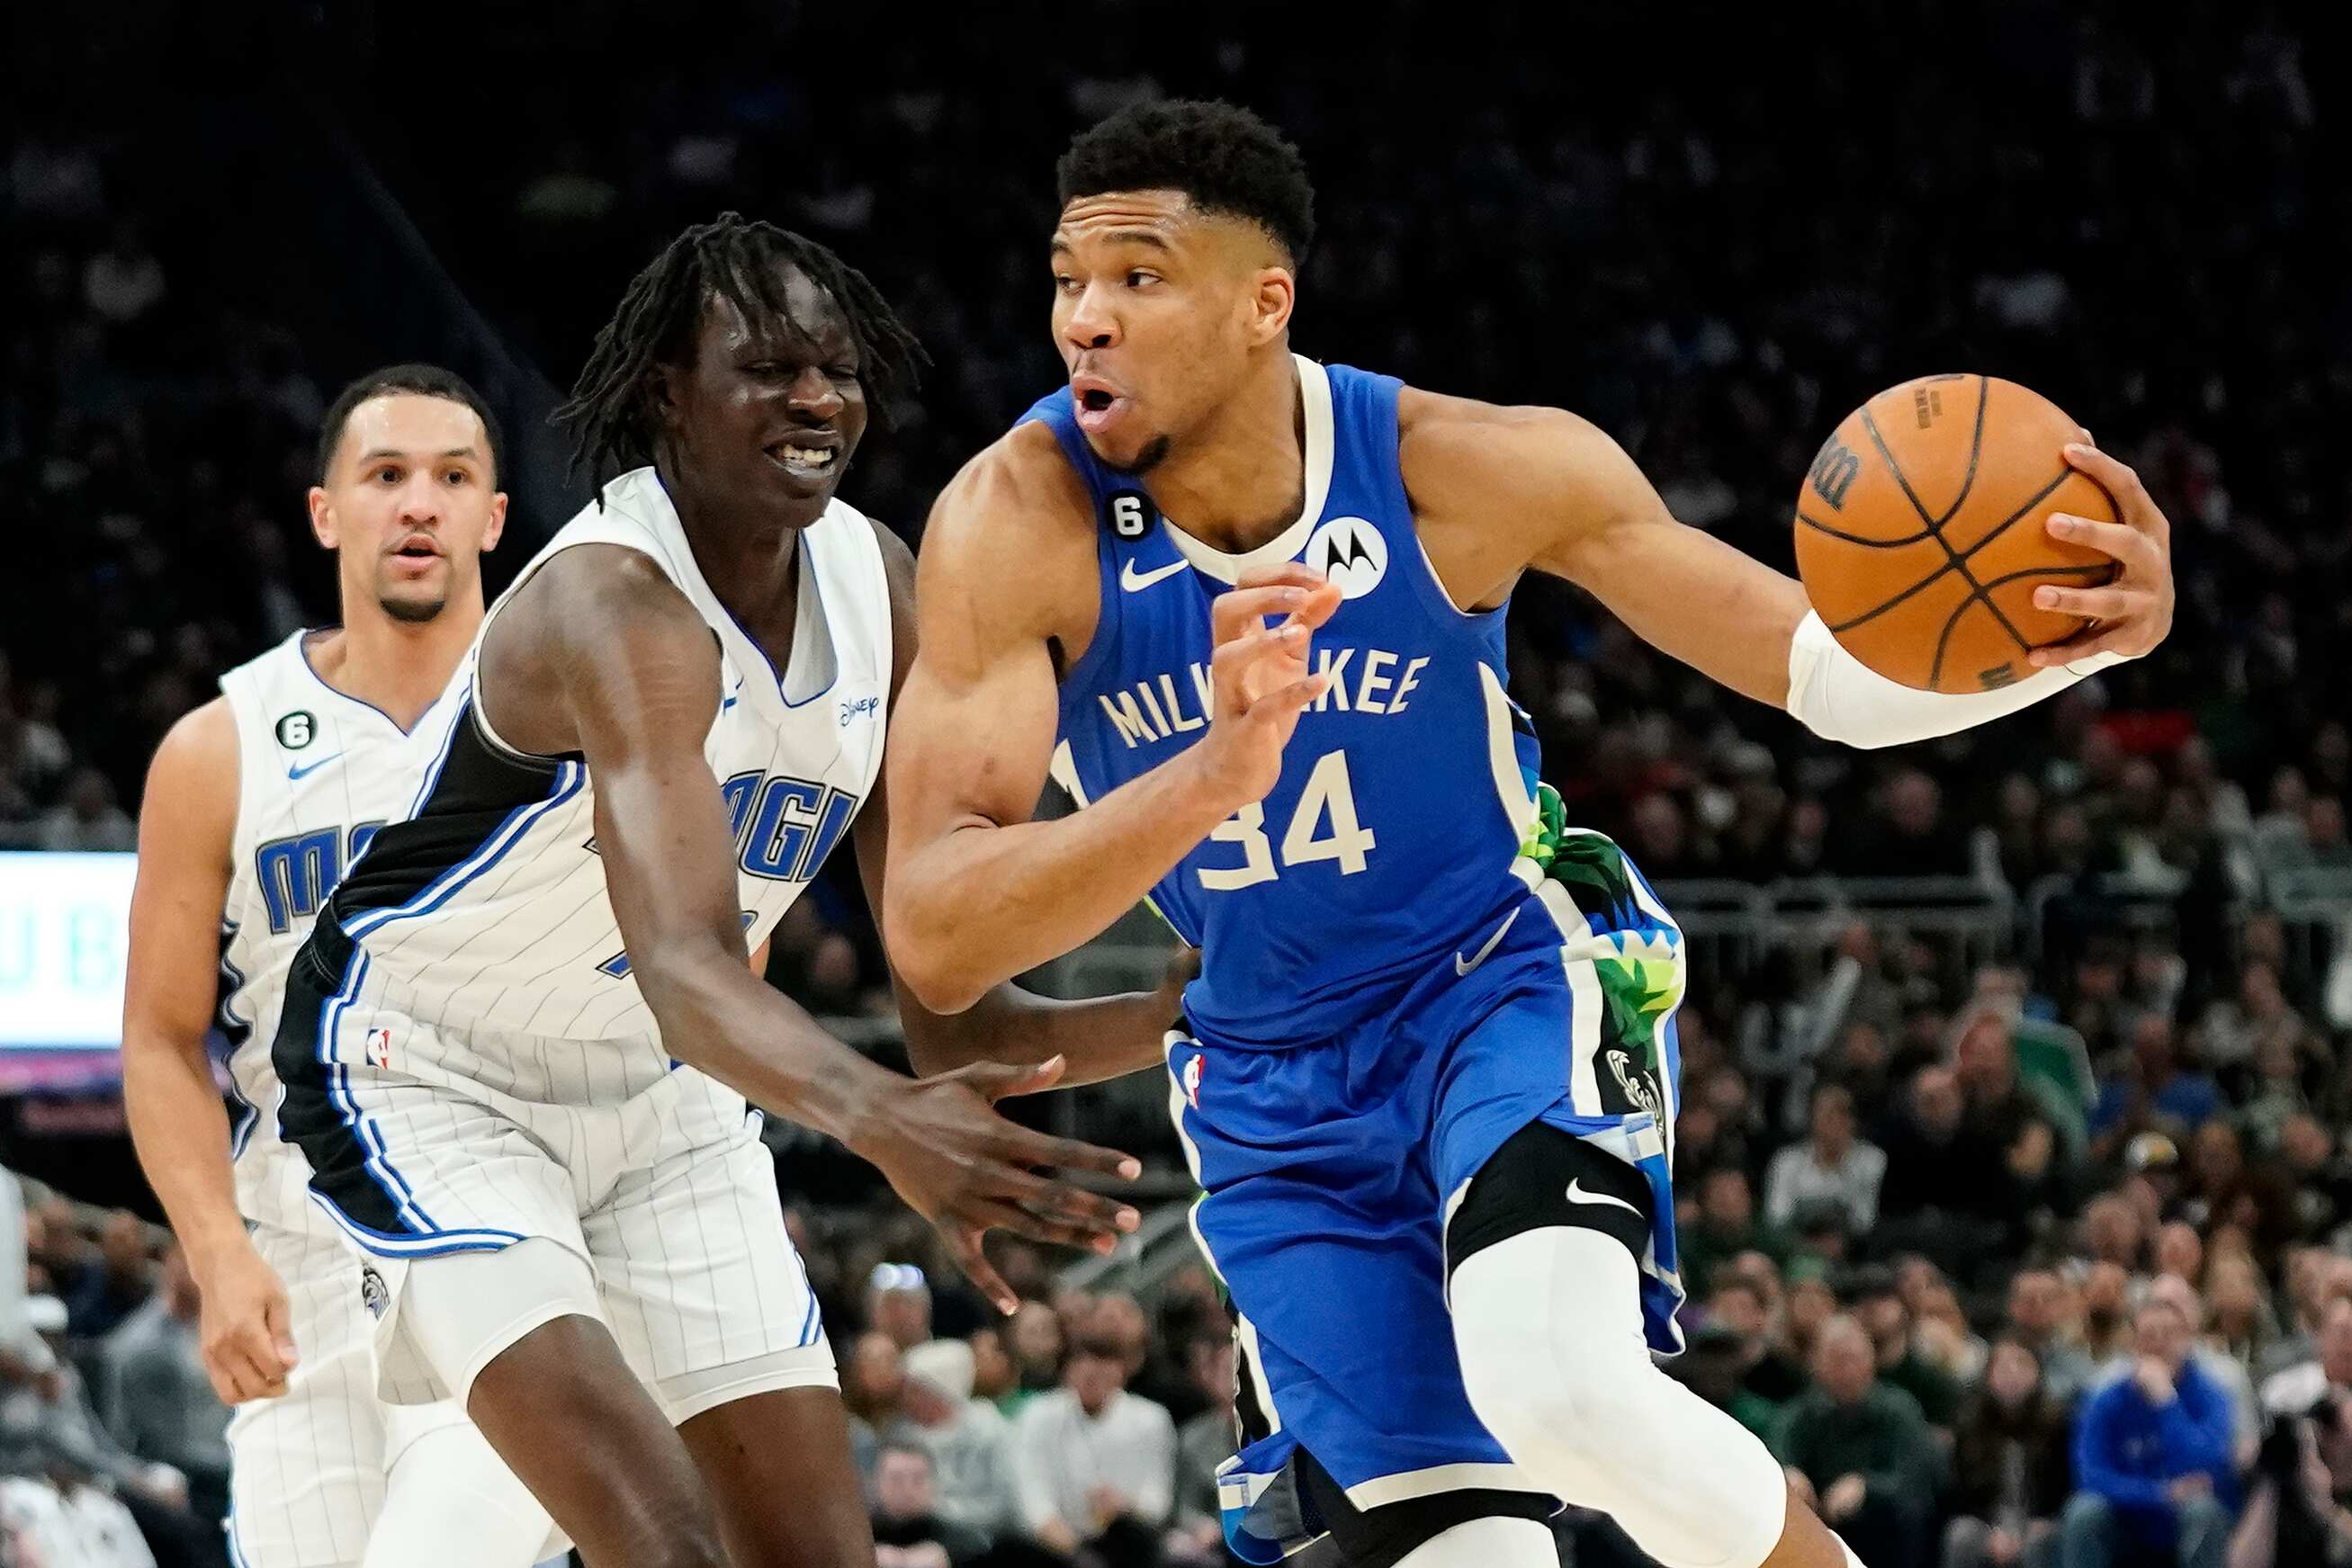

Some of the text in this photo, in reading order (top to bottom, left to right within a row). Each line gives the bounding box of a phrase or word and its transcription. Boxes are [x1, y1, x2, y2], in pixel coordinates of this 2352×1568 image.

[1113, 496, 1145, 536] 6
[284, 714, 310, 747] 6
[1098, 648, 1431, 748] MILKEE
[1198, 748, 1376, 891] 34
